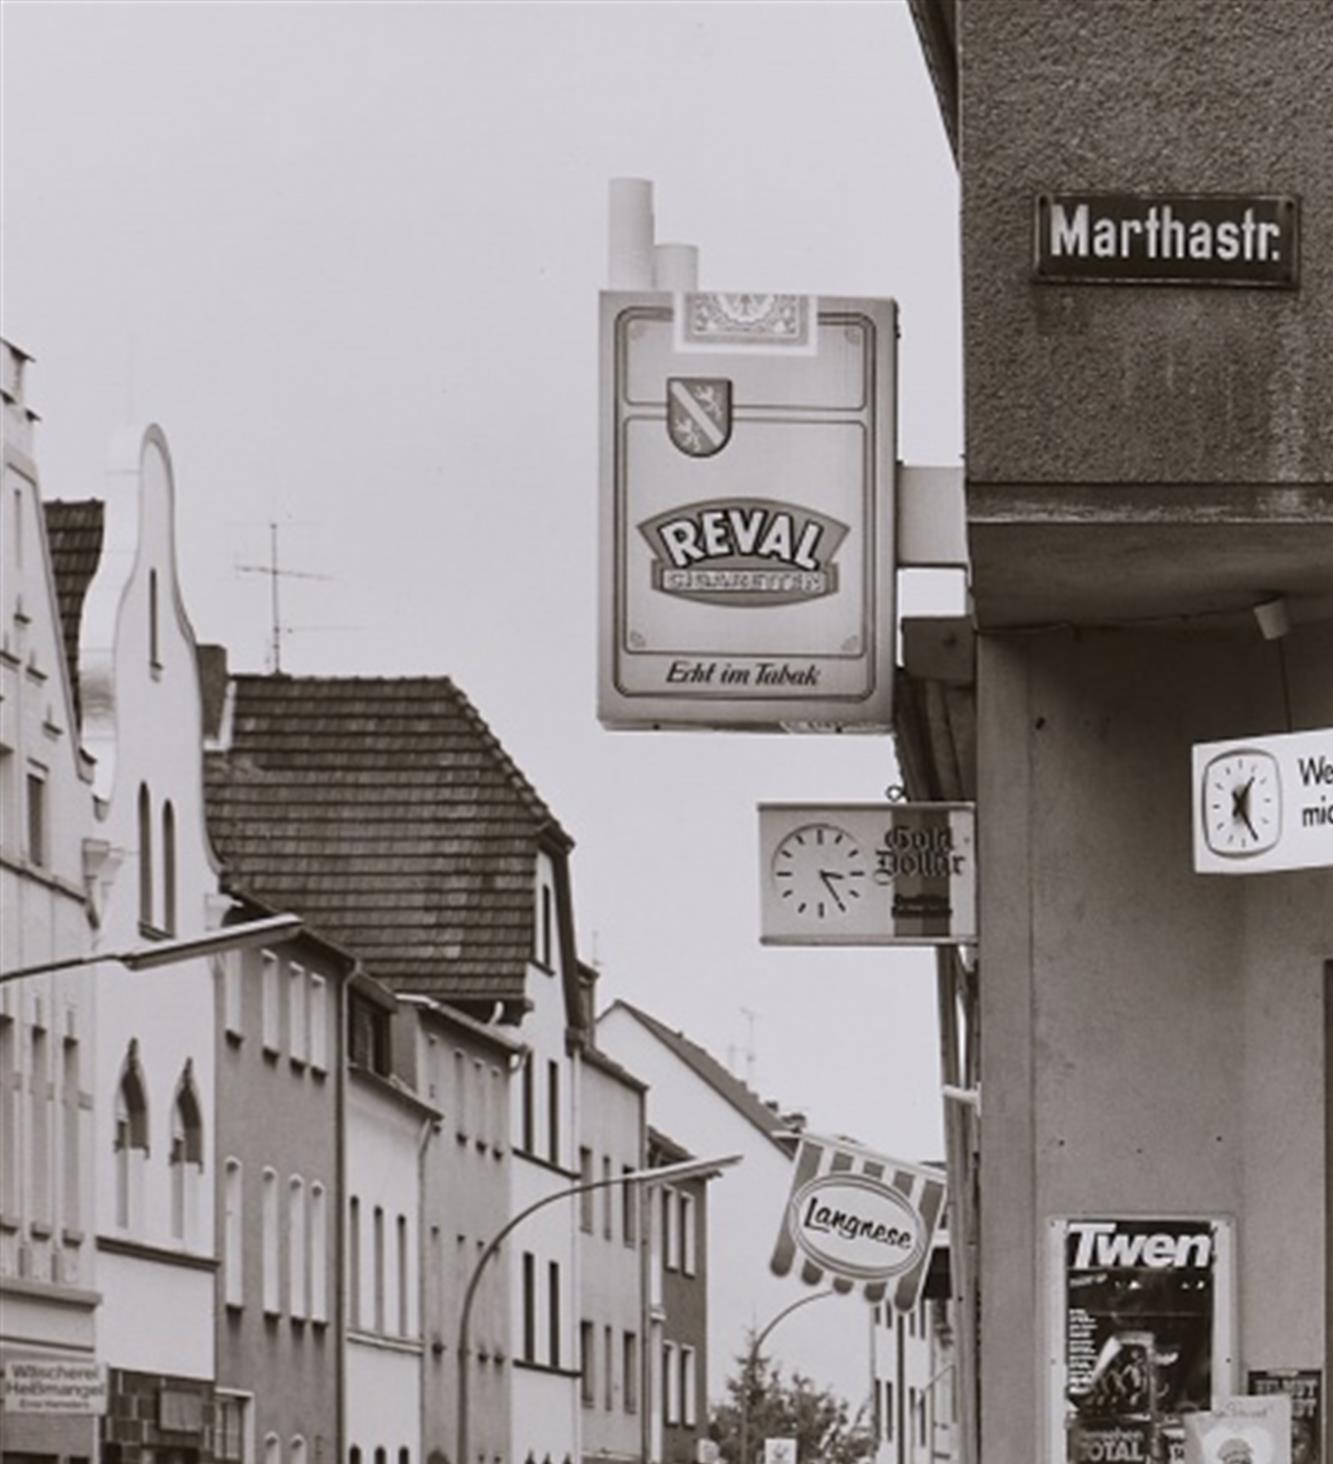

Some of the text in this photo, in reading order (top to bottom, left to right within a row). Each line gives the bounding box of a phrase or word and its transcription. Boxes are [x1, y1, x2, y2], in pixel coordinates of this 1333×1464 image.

[1050, 204, 1281, 263] Marthastr.
[657, 507, 825, 571] REVAL
[665, 660, 821, 687] Echt im Tabak
[803, 1197, 914, 1250] Langnese
[1066, 1222, 1213, 1270] Twen
